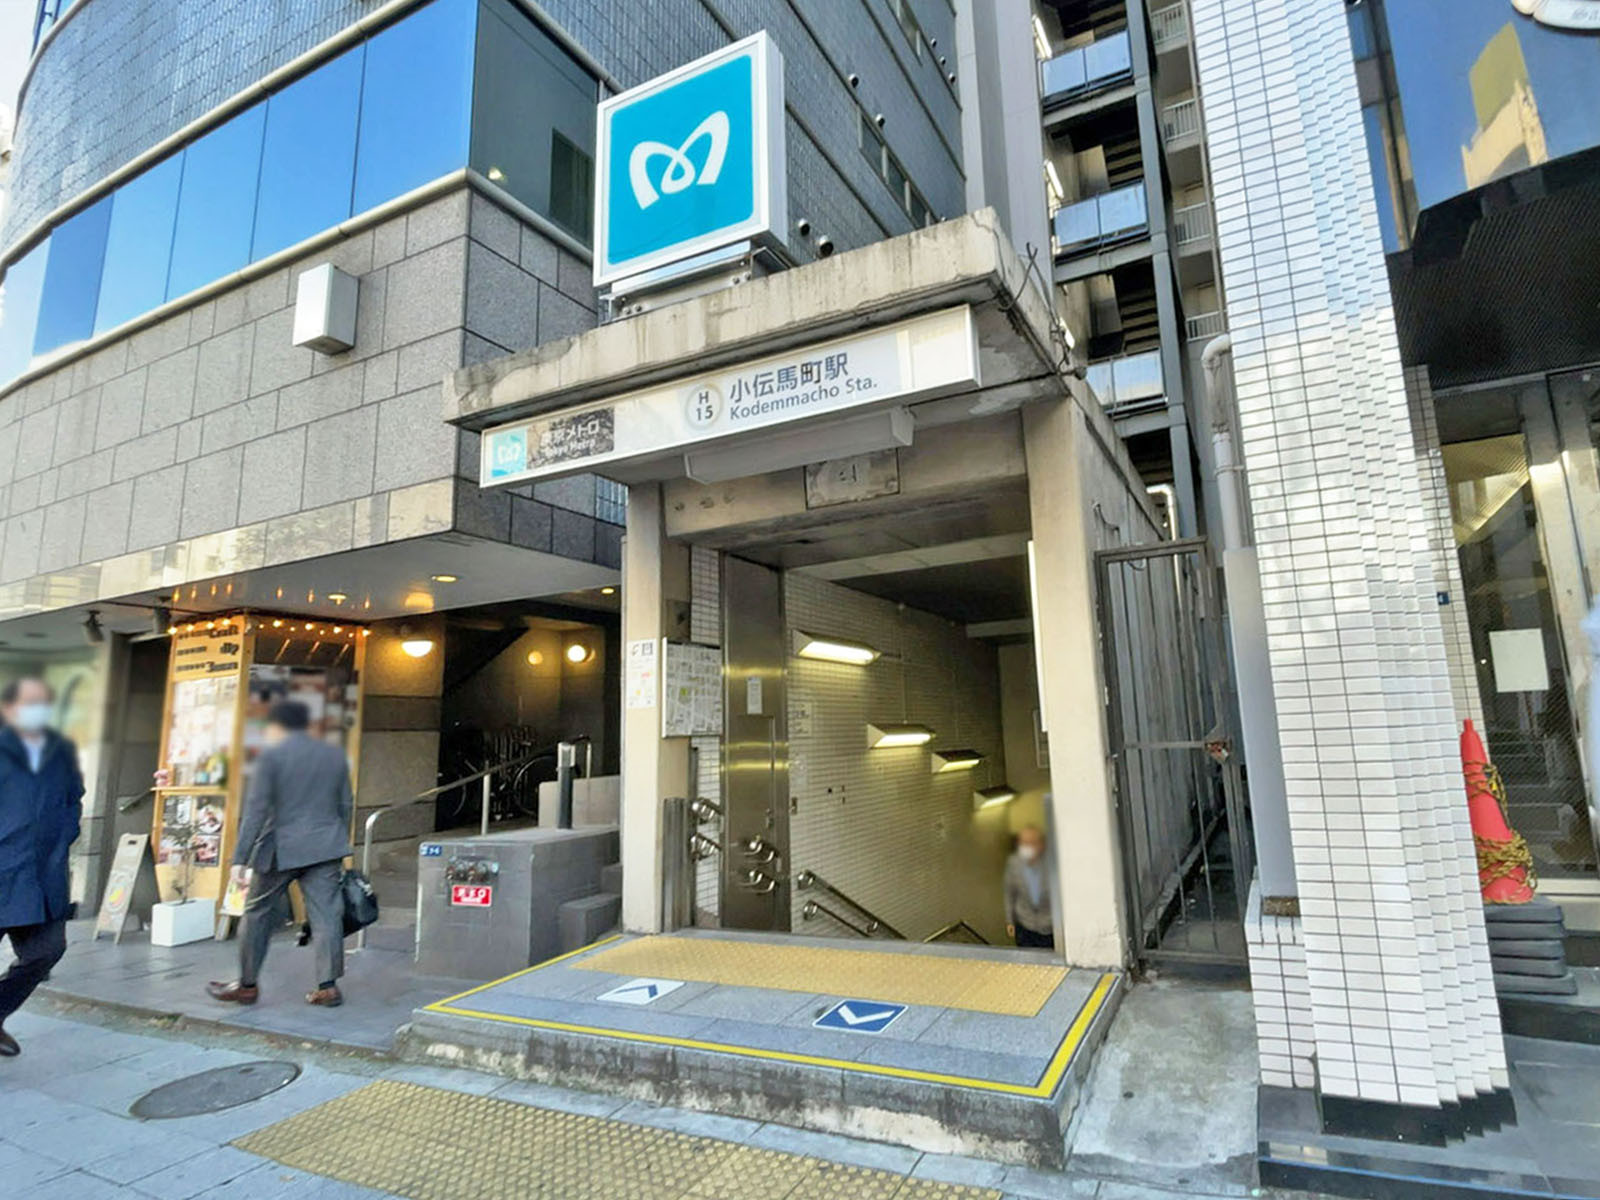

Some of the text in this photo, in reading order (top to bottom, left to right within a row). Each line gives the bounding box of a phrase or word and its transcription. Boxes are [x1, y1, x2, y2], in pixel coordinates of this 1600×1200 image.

[729, 352, 848, 403] 小伝馬町駅
[699, 391, 709, 404] H
[730, 377, 878, 420] Kodemmacho Sta.
[696, 406, 713, 421] 15
